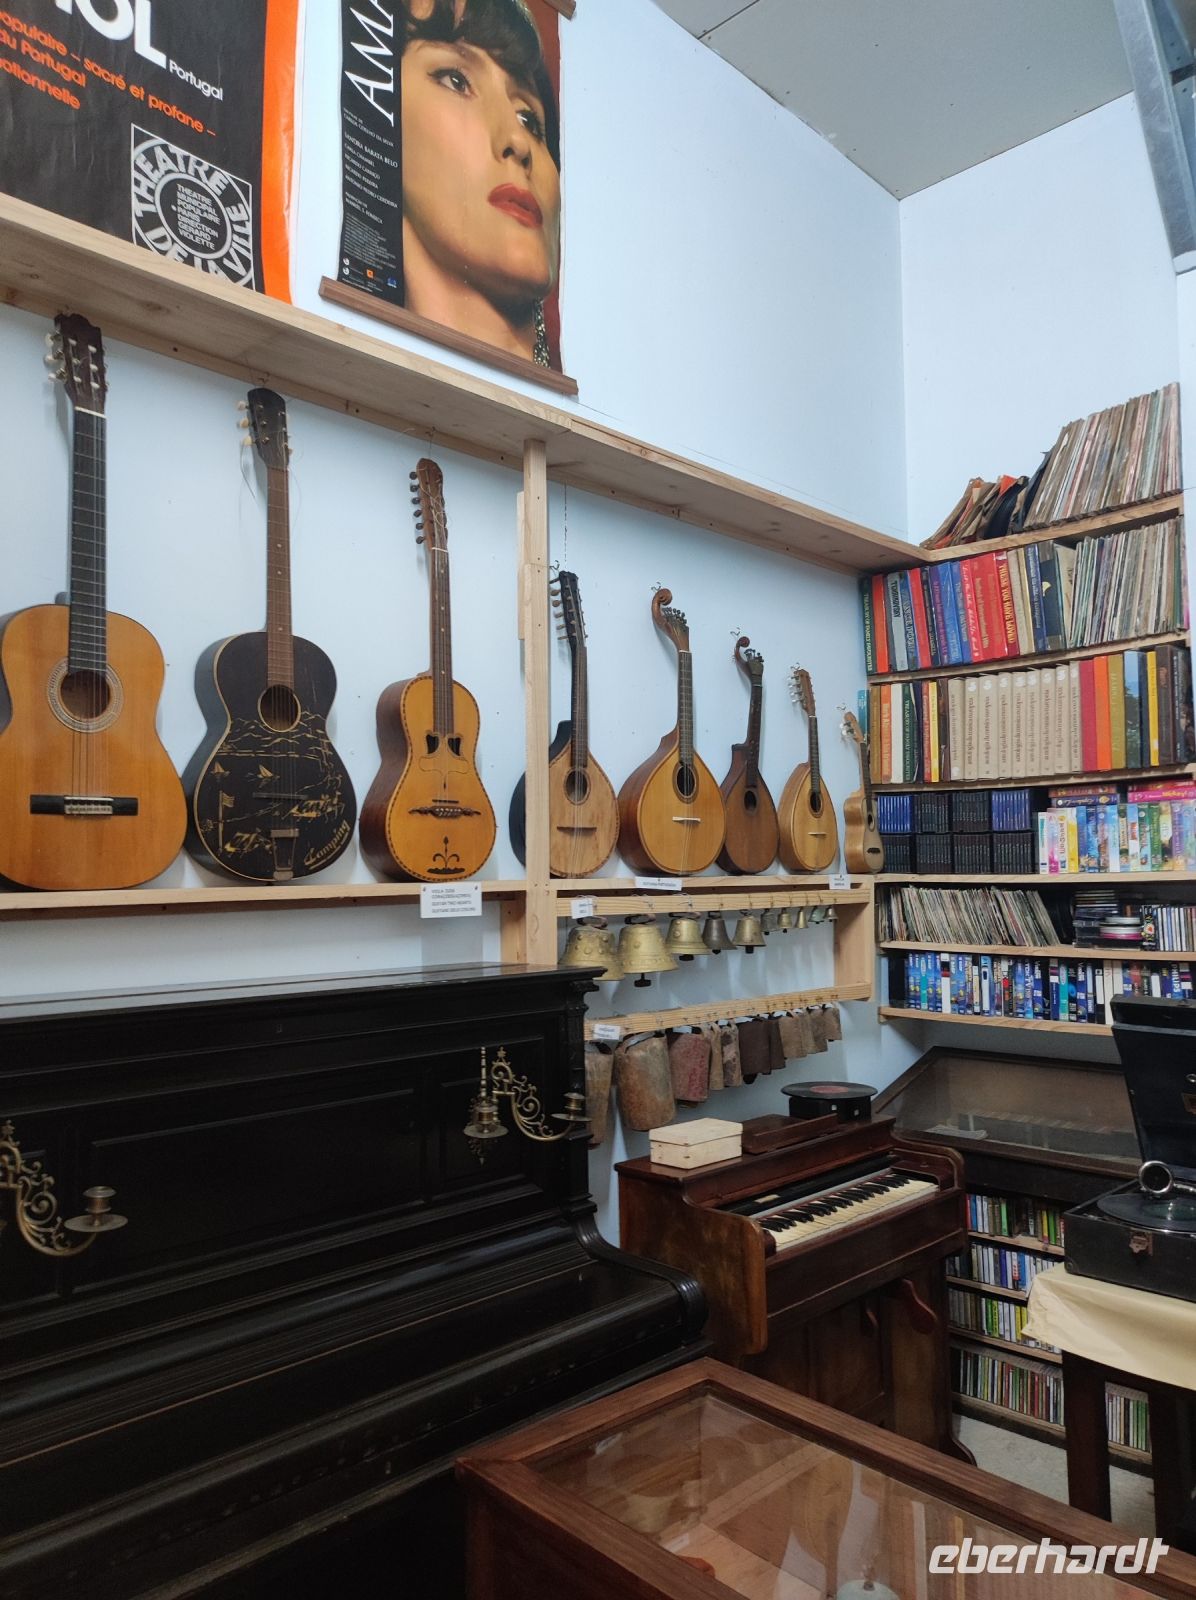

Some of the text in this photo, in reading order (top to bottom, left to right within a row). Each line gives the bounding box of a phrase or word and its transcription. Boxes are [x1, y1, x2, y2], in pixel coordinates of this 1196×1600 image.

[56, 0, 166, 69] OL
[21, 39, 86, 88] Portugal
[169, 60, 223, 101] Portugal
[84, 57, 126, 91] sacré
[130, 84, 145, 101] et
[148, 94, 204, 133] profane
[384, 154, 397, 170] BELO
[177, 183, 213, 205] THEATRE
[178, 214, 219, 238] DIRECTION
[179, 229, 215, 250] VIOLETTE
[303, 820, 351, 865] Camping
[1170, 963, 1180, 992] PHILIPS
